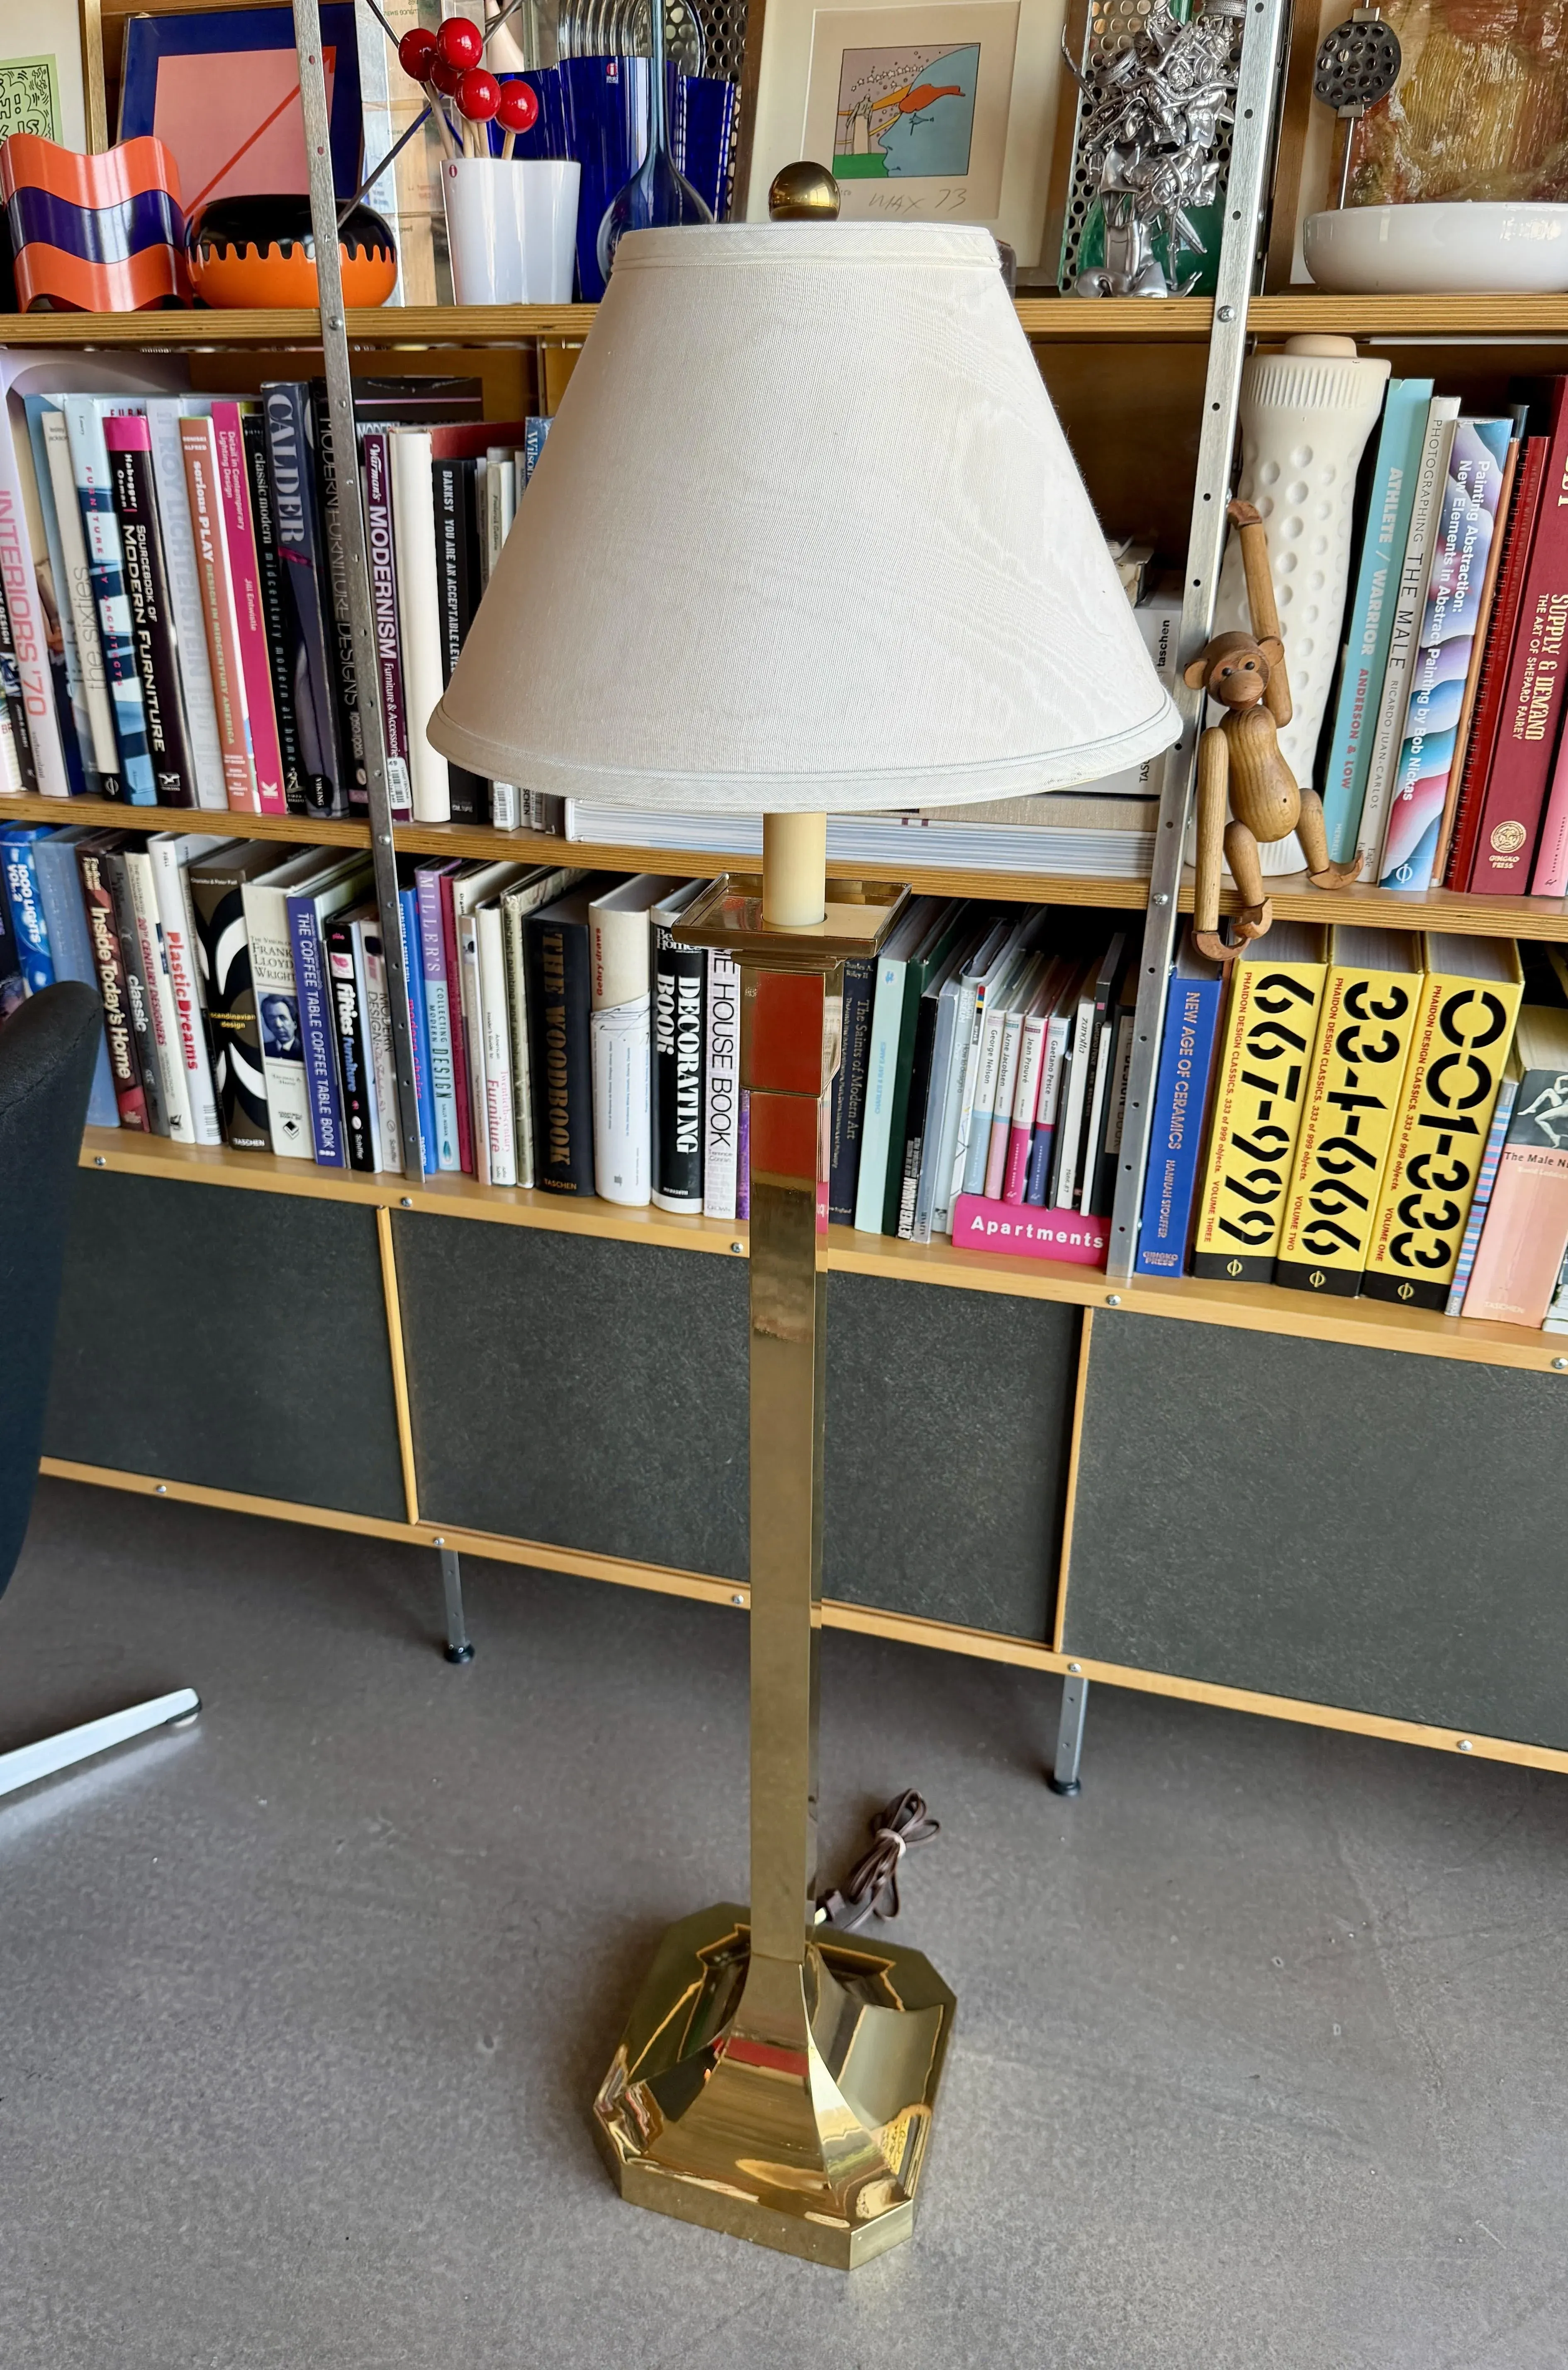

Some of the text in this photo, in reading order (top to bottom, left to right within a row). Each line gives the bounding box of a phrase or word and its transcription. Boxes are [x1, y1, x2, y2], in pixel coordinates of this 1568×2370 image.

[935, 188, 967, 211] 73
[219, 431, 232, 498] Lighting Design
[227, 431, 239, 457] Detail
[254, 453, 270, 495] classic
[268, 393, 304, 544] CALDER
[369, 444, 382, 502] Warman's
[1413, 419, 1442, 543] PHOTOGRAPHING
[193, 461, 214, 563] serious PLAY
[231, 468, 244, 531] Contemporary
[258, 496, 272, 544] modern
[1453, 460, 1491, 612] Painting Abstraction:
[0, 490, 39, 662] INTERIORS
[136, 524, 158, 622] SOURCEBOOK OF
[369, 505, 397, 658] MODERNISM
[442, 470, 460, 673] BANKSY YOU ARE AN ACCEPTABLE LEVE
[1400, 554, 1424, 598] THE
[73, 567, 101, 642] sixties
[123, 525, 165, 752] MODERN FURNITURE
[1158, 619, 1170, 667] taschen
[1341, 467, 1403, 790] ATHLETE / WARRIOR ANDERSON & LOW
[1389, 610, 1413, 670] MALE
[1402, 460, 1473, 801] New Elements in Abstract Painting by Bob Nickas
[384, 663, 395, 703] Furniture
[1512, 593, 1549, 740] THE ART OF SHEPARD FAIREY
[1525, 593, 1568, 740] SUPPLY & DEMAND
[1384, 680, 1398, 727] RICARDO
[387, 712, 401, 758] Accessorie
[297, 913, 312, 936] THE
[419, 875, 441, 973] MILLER'S
[299, 941, 318, 988] COFFEE
[595, 963, 604, 997] Gehry
[90, 907, 131, 1079] Inside Today's Home
[128, 974, 149, 1033] classic
[307, 990, 322, 1028] TABLE
[436, 988, 448, 1043] COLLECTING
[657, 974, 675, 1055] BOOK
[1238, 972, 1252, 1015] PHAIDON
[1329, 978, 1344, 1019] PHAIDON
[1426, 985, 1443, 1027] PHAIDON
[178, 1000, 198, 1070] Dreams
[209, 1012, 256, 1022] scandinavian
[220, 1021, 246, 1030] design
[1233, 1015, 1245, 1048] DESIGN
[1322, 1021, 1335, 1055] DESIGN
[311, 1031, 328, 1076] COFFEE
[429, 1005, 452, 1099] MODERN DESIGN
[543, 933, 571, 1166] THE WOODBOOK
[676, 976, 701, 1154] DECORATING
[710, 983, 735, 1148] HOUSE BOOK
[846, 1000, 869, 1140] The Saints of Modern Art
[984, 1029, 998, 1084] George Nelson
[1000, 1033, 1012, 1087] Arne Jacobsen
[1023, 1038, 1034, 1083] Jean Prouvé
[1045, 1040, 1058, 1095] Gaetano Pesce
[1418, 1029, 1432, 1064] DESIGN
[317, 1079, 331, 1115] TABLE
[487, 1079, 502, 1153] Furniture
[1157, 992, 1200, 1239] NEW AGE OF CERAMICS HANNAH STOUFFER
[1218, 974, 1315, 1245] 667-999
[1222, 1116, 1229, 1125] of
[1223, 1098, 1232, 1114] 333
[1310, 1105, 1320, 1122] 333
[1219, 1126, 1228, 1142] 999
[1305, 1134, 1315, 1150] 999
[1309, 1123, 1316, 1132] of
[1401, 1133, 1410, 1142] of
[1403, 1114, 1414, 1131] 333
[1397, 1143, 1408, 1160] 999
[1505, 1151, 1554, 1166] The Male
[544, 1178, 577, 1190] TASCHEN
[1208, 1181, 1220, 1214] VOLUME
[970, 1216, 1104, 1249] Apartments
[1204, 1216, 1215, 1243] THREE
[1290, 1195, 1304, 1229] VOLUME
[1381, 1208, 1395, 1242] VOLUME
[1286, 1232, 1297, 1251] TWO
[1376, 1244, 1385, 1262] ONE
